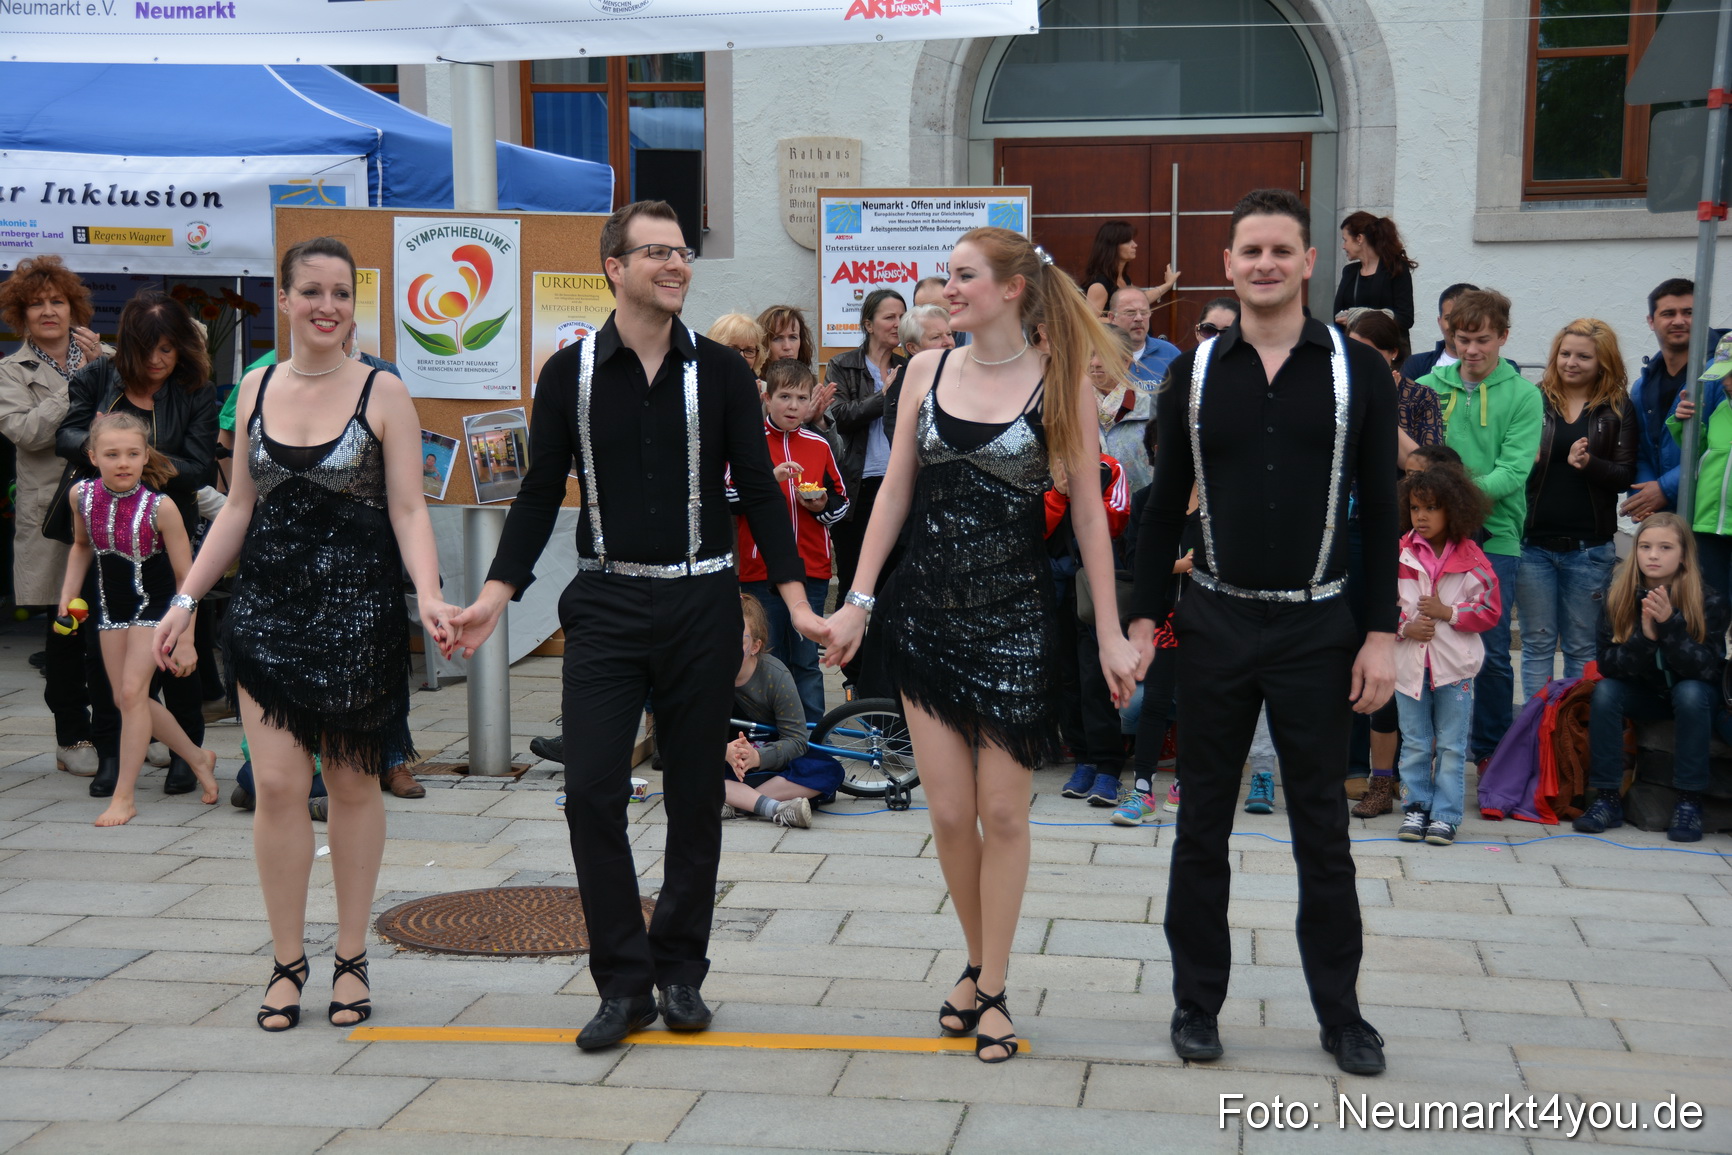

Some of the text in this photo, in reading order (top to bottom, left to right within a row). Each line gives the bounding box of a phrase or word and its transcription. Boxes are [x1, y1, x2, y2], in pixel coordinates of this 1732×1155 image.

[0, 0, 117, 16] Neumarkt e.V.
[135, 1, 236, 19] Neumarkt
[789, 147, 850, 160] Rathaus
[40, 181, 224, 209] Inklusion
[862, 201, 904, 210] Neumarkt
[911, 201, 934, 210] Offen
[936, 201, 951, 210] und
[953, 200, 986, 210] inklusiv
[1, 230, 64, 239] rnberger Land
[93, 230, 167, 244] Regens Wagner
[405, 226, 512, 255] SYMPATHIEBLUME
[825, 244, 874, 252] Unterstützer
[908, 243, 940, 251] sozialen
[541, 276, 609, 290] URKUND
